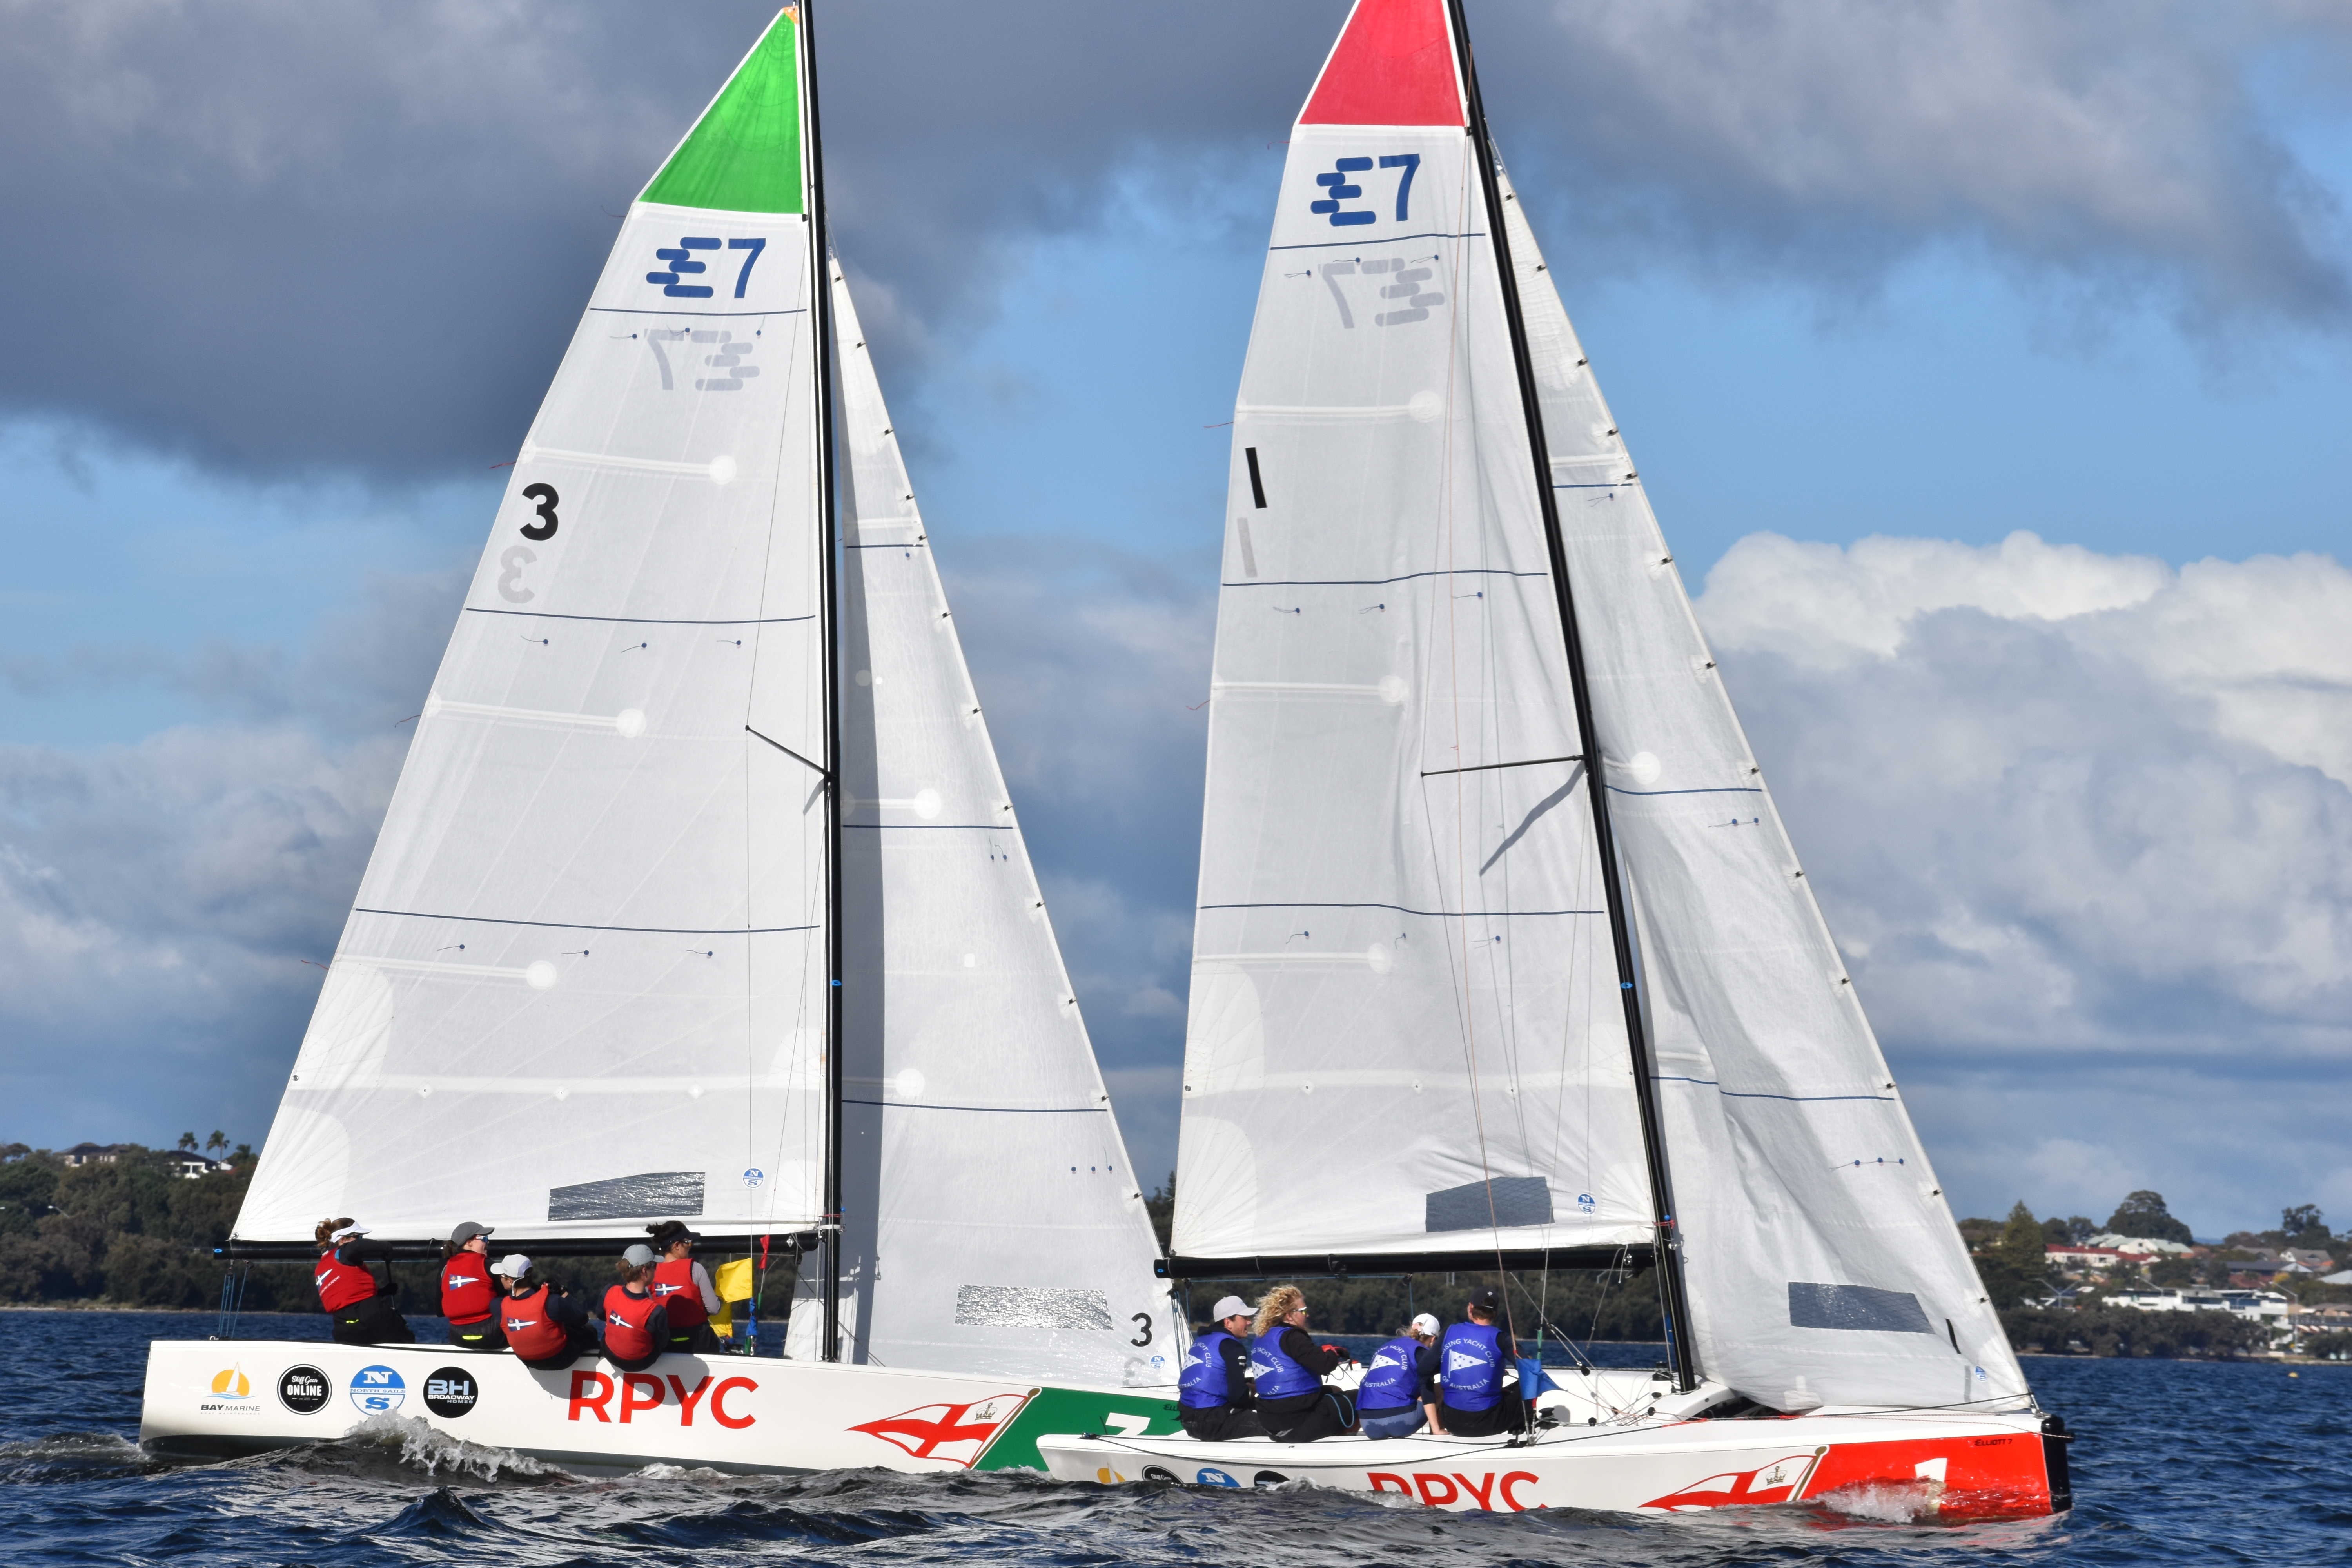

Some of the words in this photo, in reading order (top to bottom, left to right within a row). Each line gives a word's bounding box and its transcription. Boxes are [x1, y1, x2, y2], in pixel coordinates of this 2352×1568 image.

[1310, 153, 1421, 227] E7
[646, 236, 766, 299] E7
[519, 483, 559, 541] 3
[1131, 1312, 1152, 1347] 3
[1390, 1345, 1405, 1354] YACHT
[1463, 1338, 1487, 1350] YACHT
[1485, 1351, 1495, 1368] CLUB
[1271, 1357, 1284, 1373] CLUB
[305, 1376, 318, 1385] Gear
[363, 1371, 393, 1383] N
[1364, 1378, 1396, 1387] AUSTRALIA
[287, 1385, 322, 1396] ONLINE
[428, 1379, 469, 1396] BH
[1449, 1379, 1489, 1390] AUSTRALIA
[365, 1397, 390, 1410] S
[568, 1370, 759, 1429] RPYC
[1201, 1472, 1225, 1483] N
